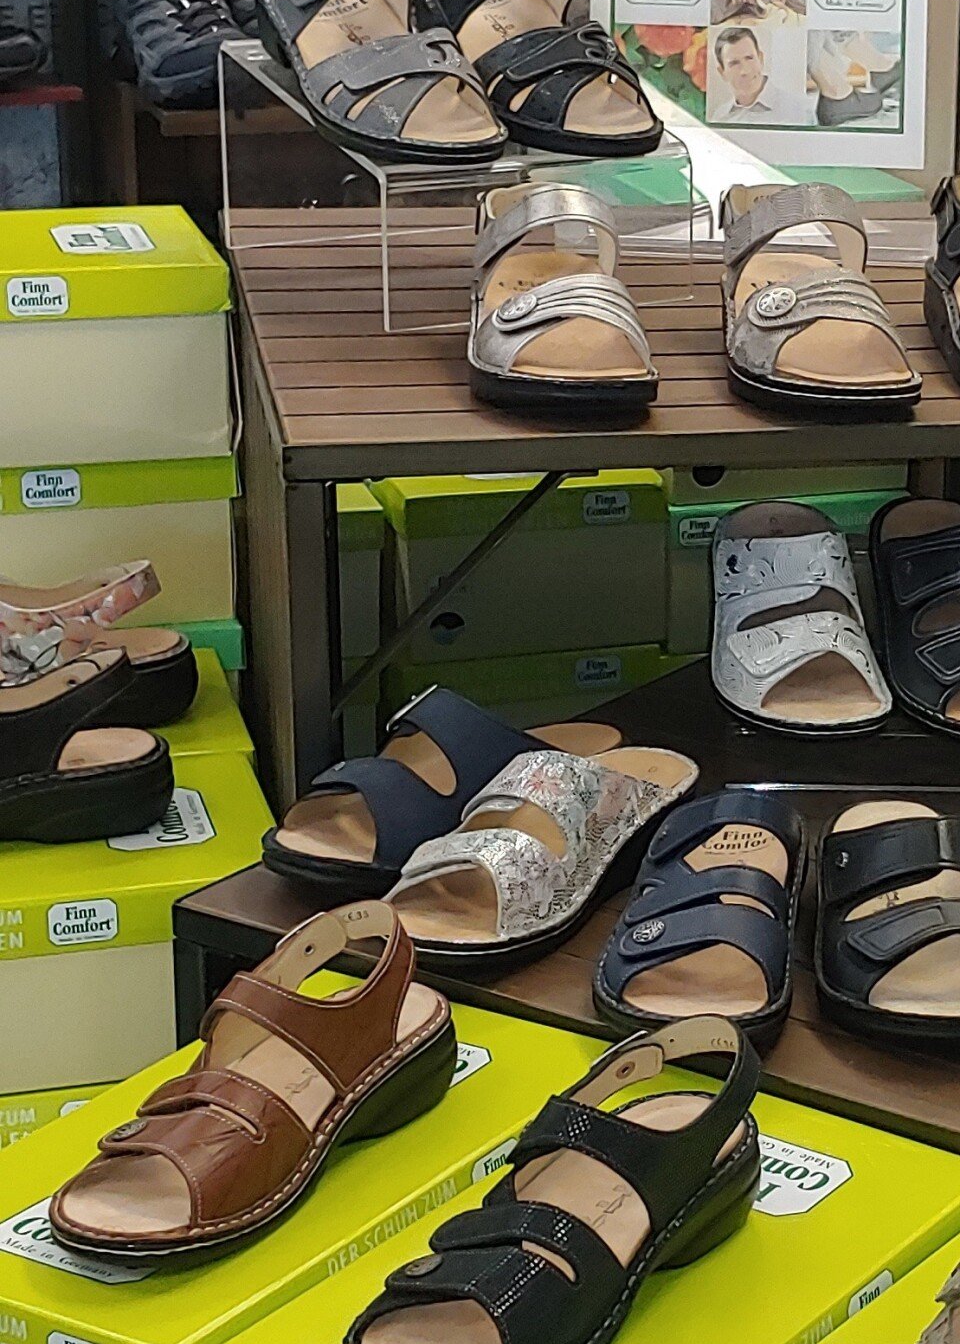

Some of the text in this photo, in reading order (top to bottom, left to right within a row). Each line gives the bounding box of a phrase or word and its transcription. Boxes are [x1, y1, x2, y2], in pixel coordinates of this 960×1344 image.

[22, 281, 50, 296] Finn
[11, 294, 64, 307] Comfort
[36, 474, 63, 489] Finn
[25, 486, 77, 500] Comfort
[65, 906, 97, 920] Finn
[53, 919, 112, 936] Comfort
[327, 1177, 458, 1276] DER SCHUH ZUM
